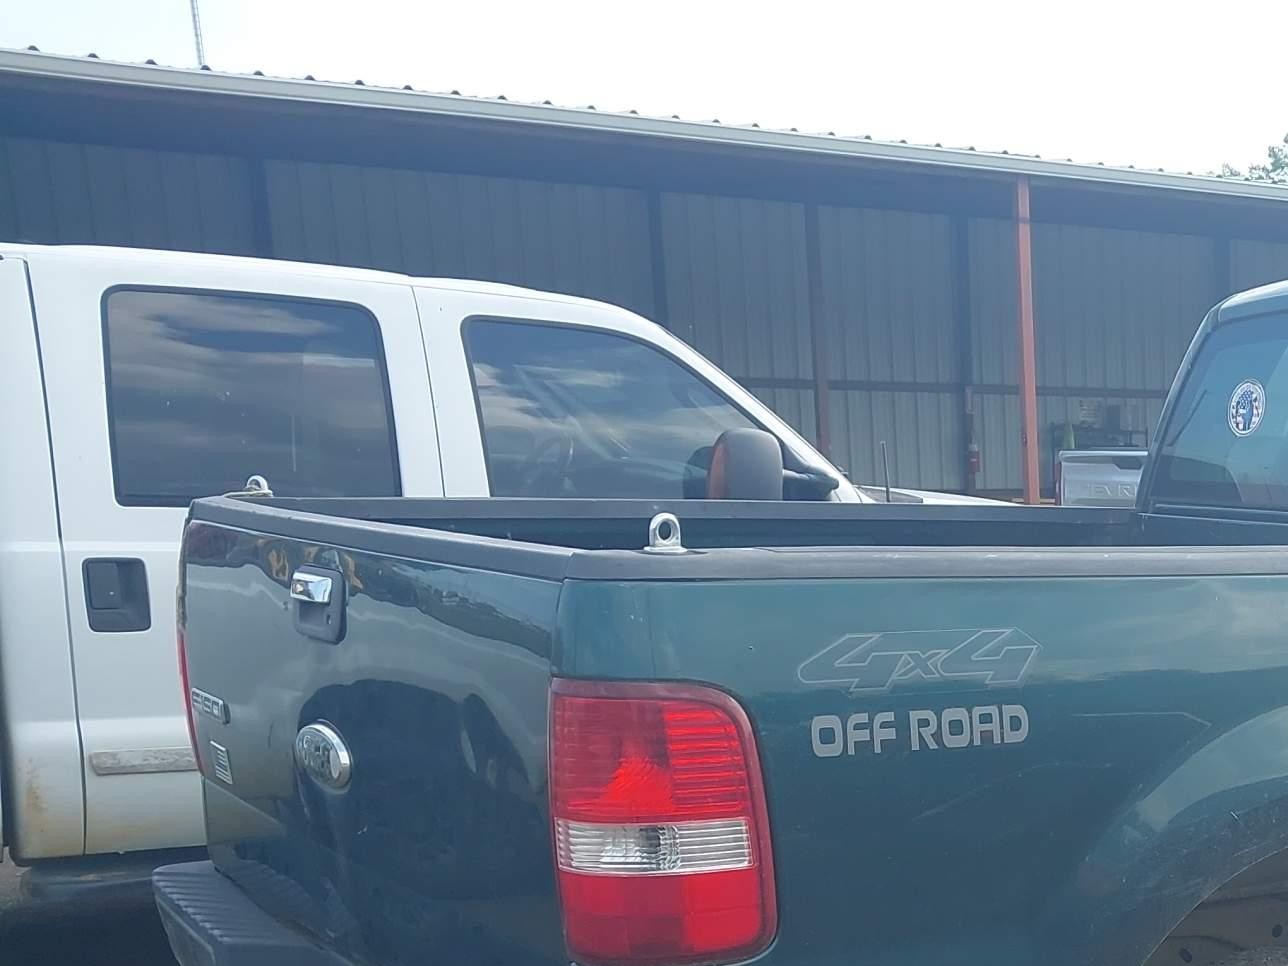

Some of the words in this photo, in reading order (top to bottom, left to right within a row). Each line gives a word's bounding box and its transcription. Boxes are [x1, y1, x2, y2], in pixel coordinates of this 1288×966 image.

[797, 628, 1039, 692] 4x4
[811, 711, 897, 758] OFF
[908, 704, 1029, 751] ROAD
